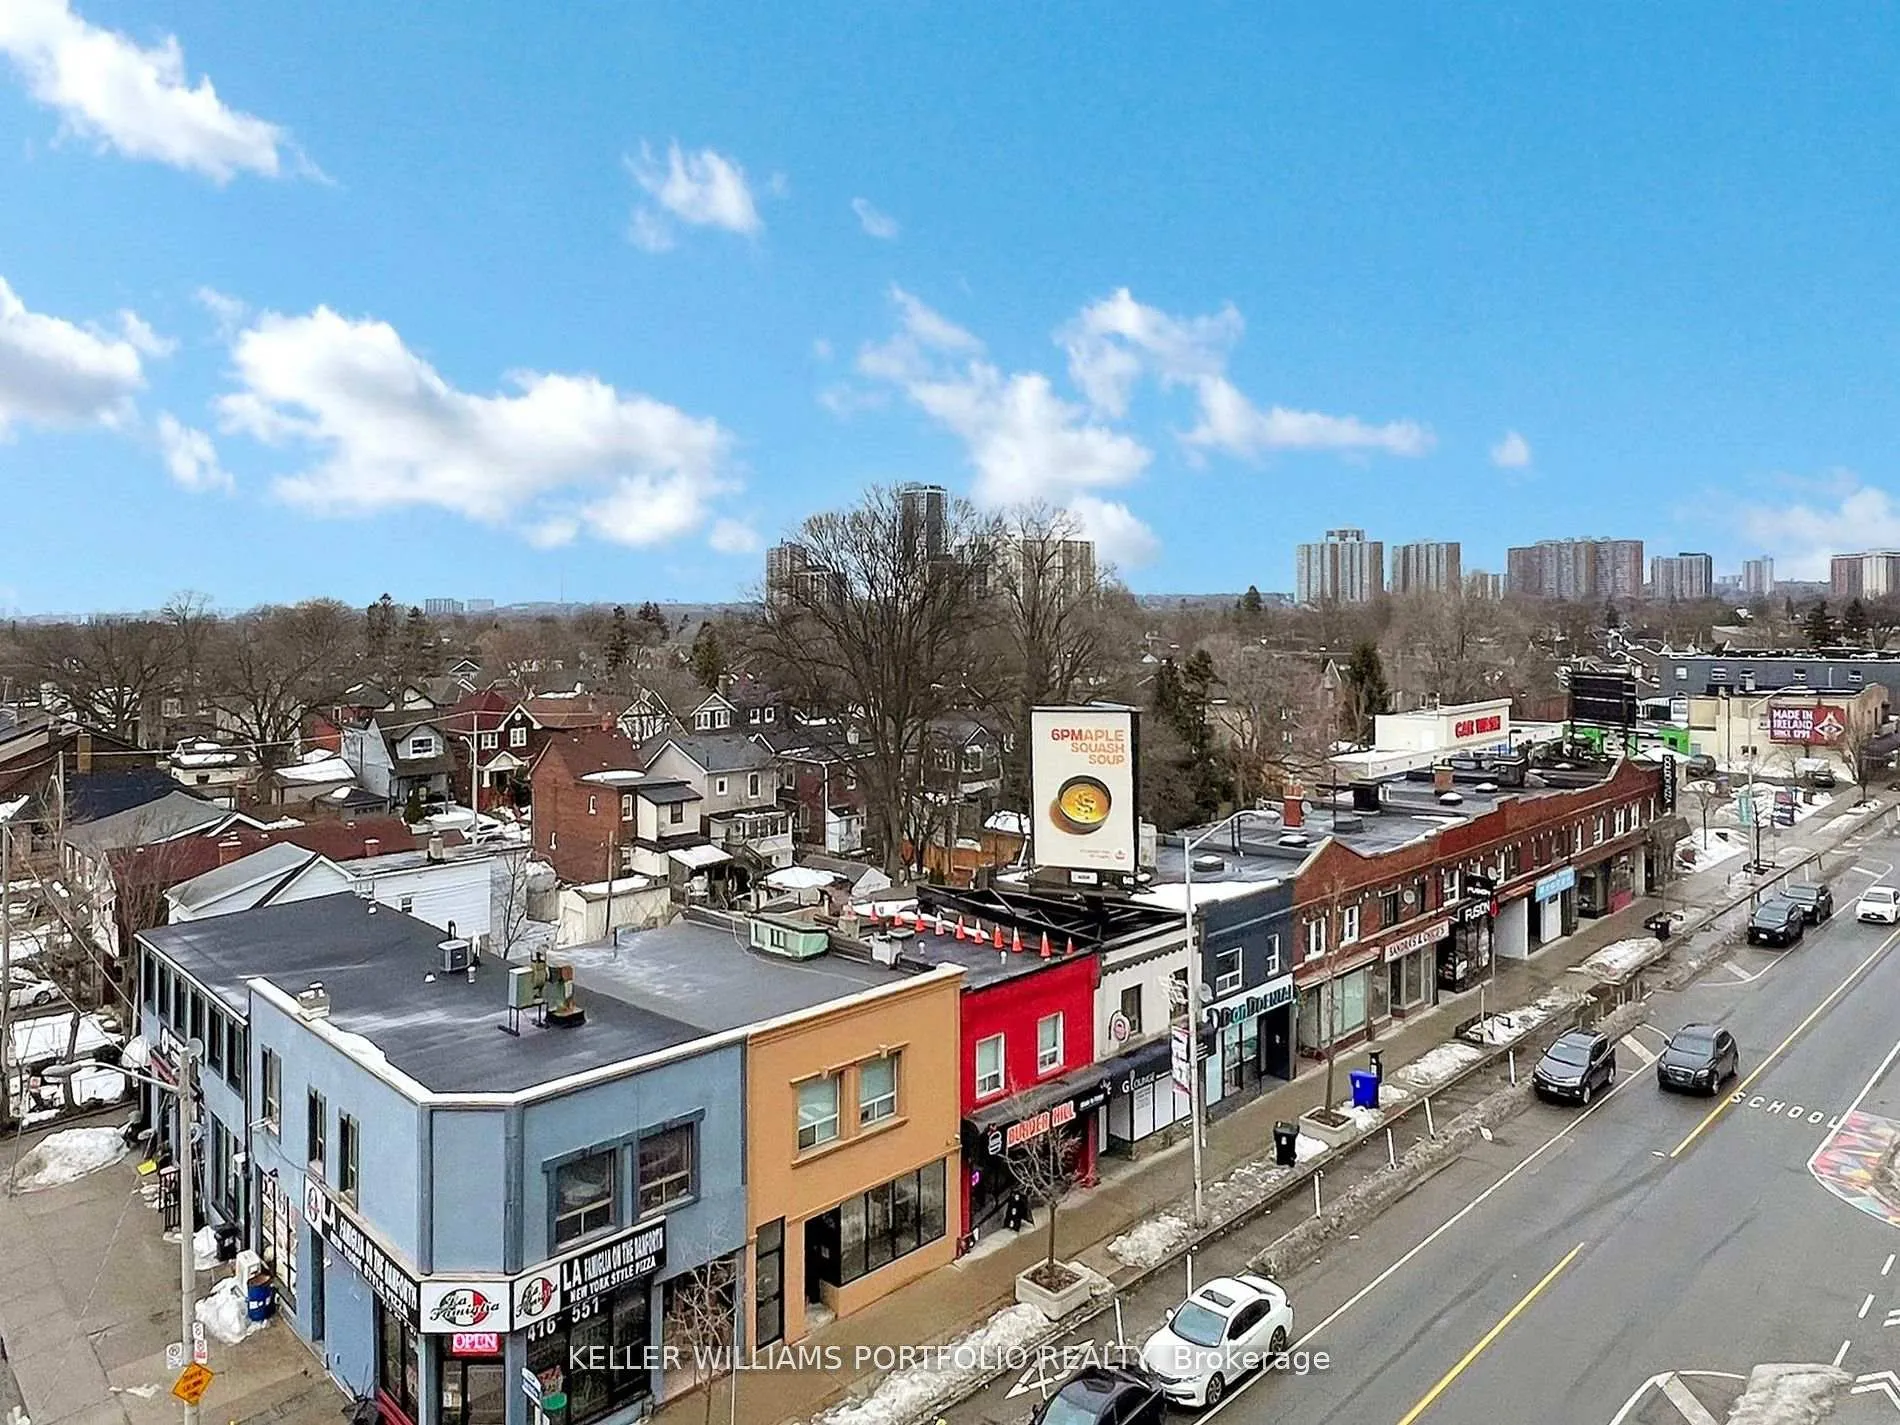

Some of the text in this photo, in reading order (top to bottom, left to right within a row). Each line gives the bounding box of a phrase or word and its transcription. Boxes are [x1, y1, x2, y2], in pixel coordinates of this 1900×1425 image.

[1773, 710, 1813, 720] MADE IN
[1455, 720, 1474, 738] CAR
[1773, 720, 1813, 730] IRELAND
[1051, 728, 1125, 742] 6PMAPLE
[1071, 742, 1125, 754] SQUASH
[1088, 755, 1125, 766] SOUP
[1465, 901, 1490, 922] FUSION
[1730, 1090, 1839, 1129] SCHOOL
[322, 1195, 336, 1231] LA
[562, 1259, 582, 1291] LA
[570, 1284, 588, 1303] NEW
[589, 1275, 610, 1294] YORK
[611, 1264, 634, 1286] STYLE
[636, 1255, 656, 1275] PIZZA
[364, 1264, 385, 1293] STYLE
[385, 1286, 409, 1318] PIZZA
[453, 1333, 497, 1350] OPEN
